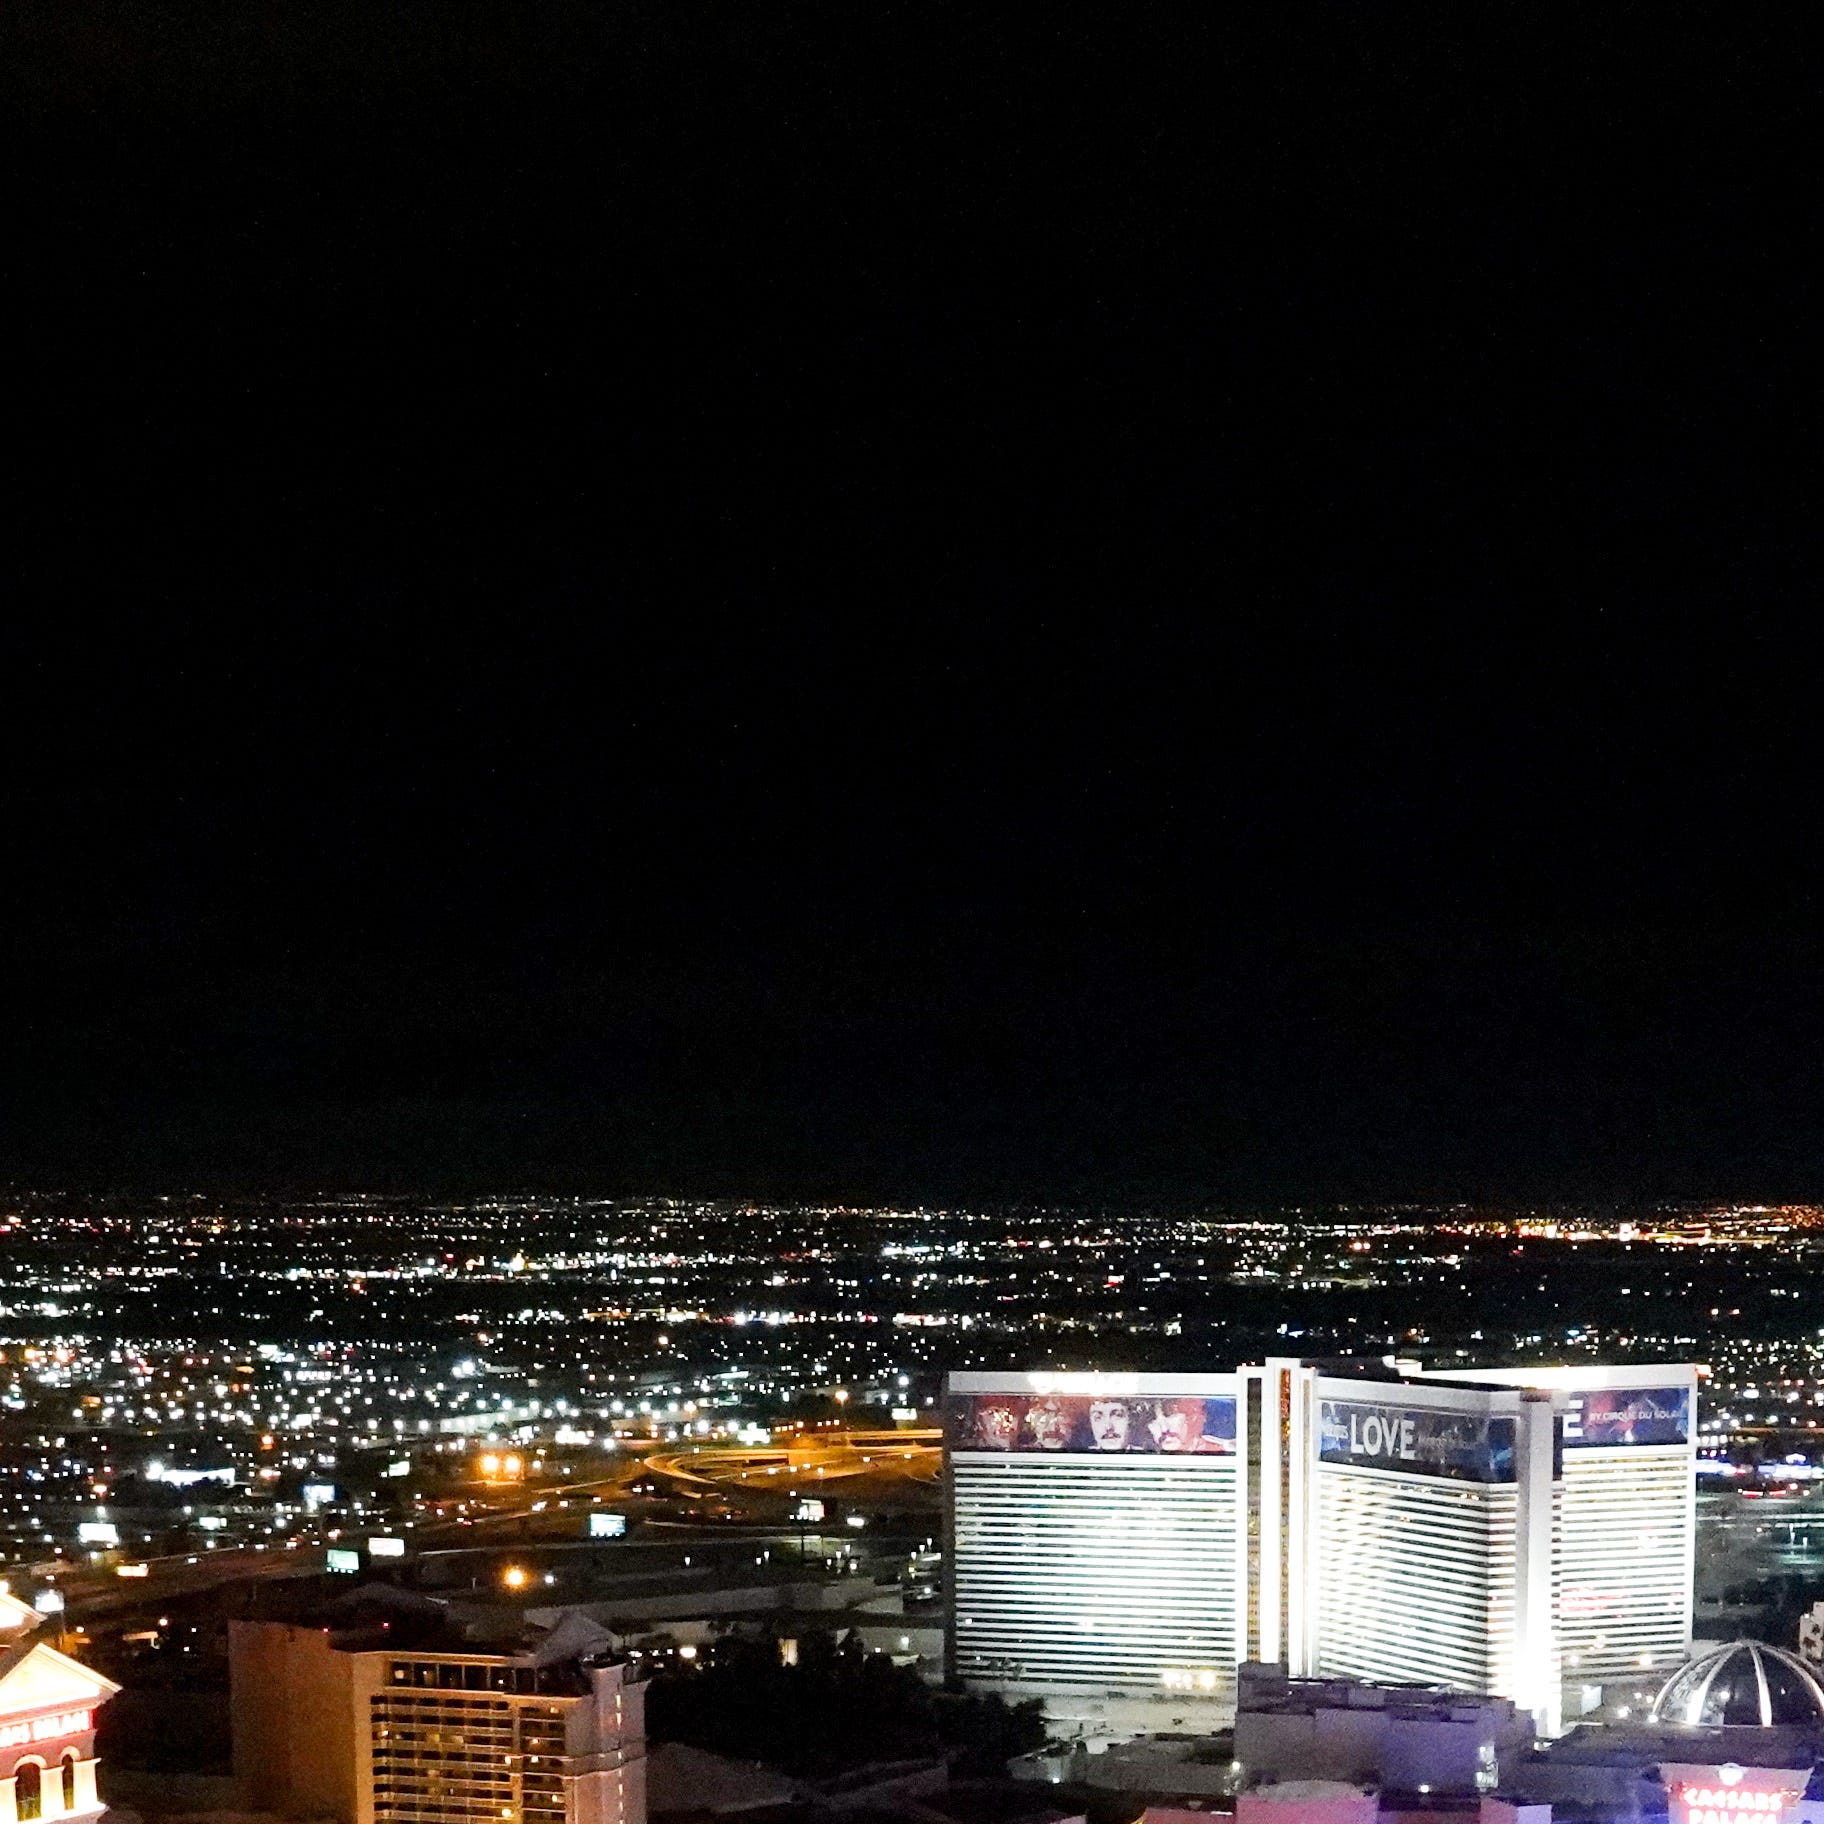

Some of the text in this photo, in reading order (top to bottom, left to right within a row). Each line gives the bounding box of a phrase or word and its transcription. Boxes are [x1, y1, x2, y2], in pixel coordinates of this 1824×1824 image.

[1350, 1413, 1416, 1460] LOVE
[32, 1709, 91, 1741] PALACE
[1683, 1787, 1783, 1812] CAESARS
